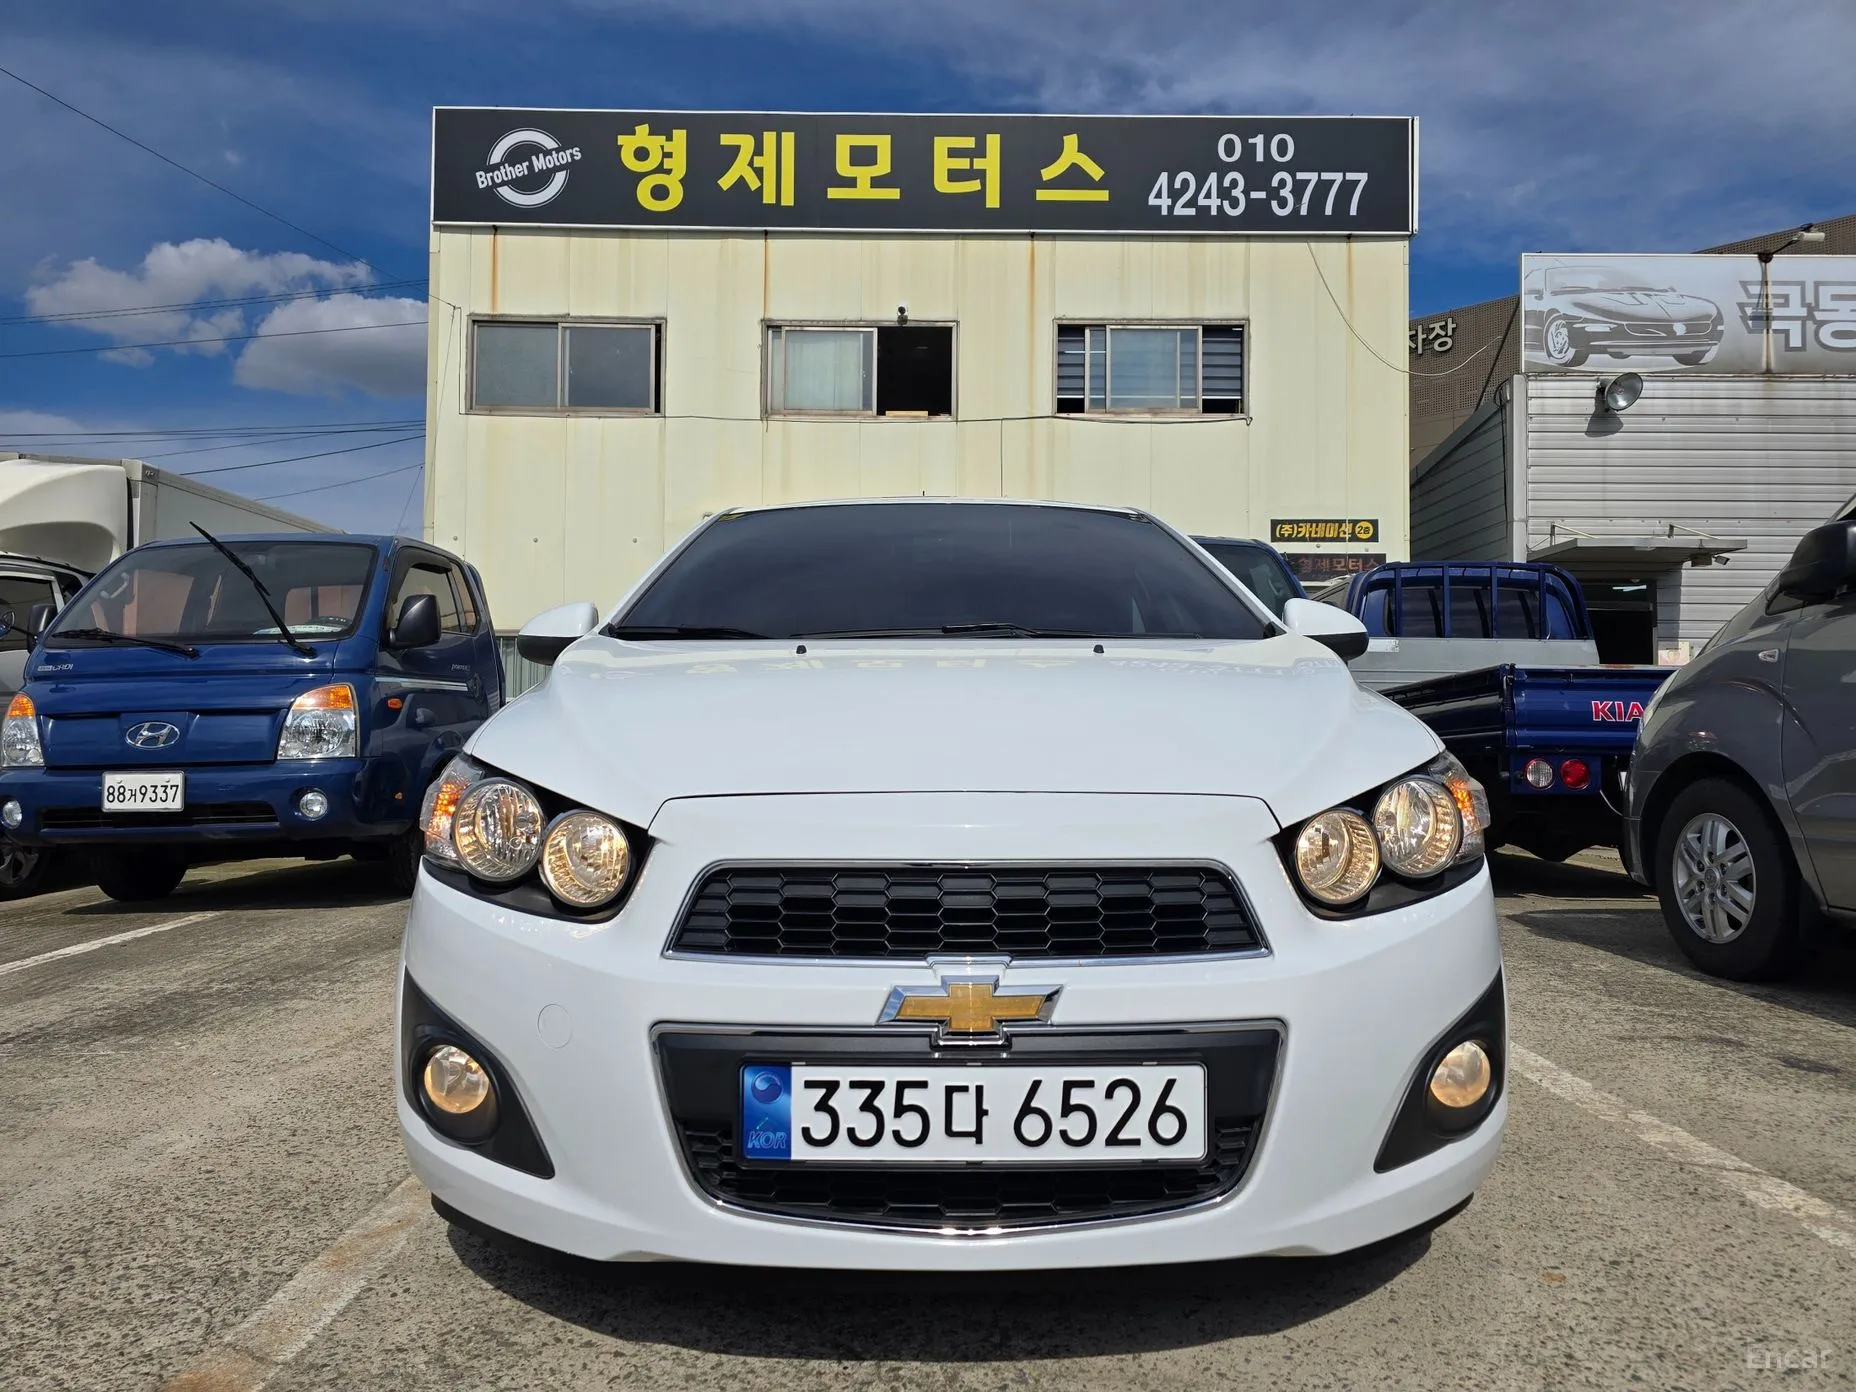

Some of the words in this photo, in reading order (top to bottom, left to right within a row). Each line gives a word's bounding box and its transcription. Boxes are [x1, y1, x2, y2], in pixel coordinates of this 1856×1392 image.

[1217, 133, 1296, 163] 010
[475, 161, 530, 189] Brother
[531, 146, 582, 173] Motors
[618, 123, 1109, 213] 형제모터스
[1148, 171, 1369, 217] 4243-3777
[1591, 700, 1645, 722] KIA
[106, 784, 179, 803] 88거9337
[801, 1079, 990, 1148] 335다
[1013, 1078, 1188, 1148] 6526
[747, 1131, 787, 1149] KOR
